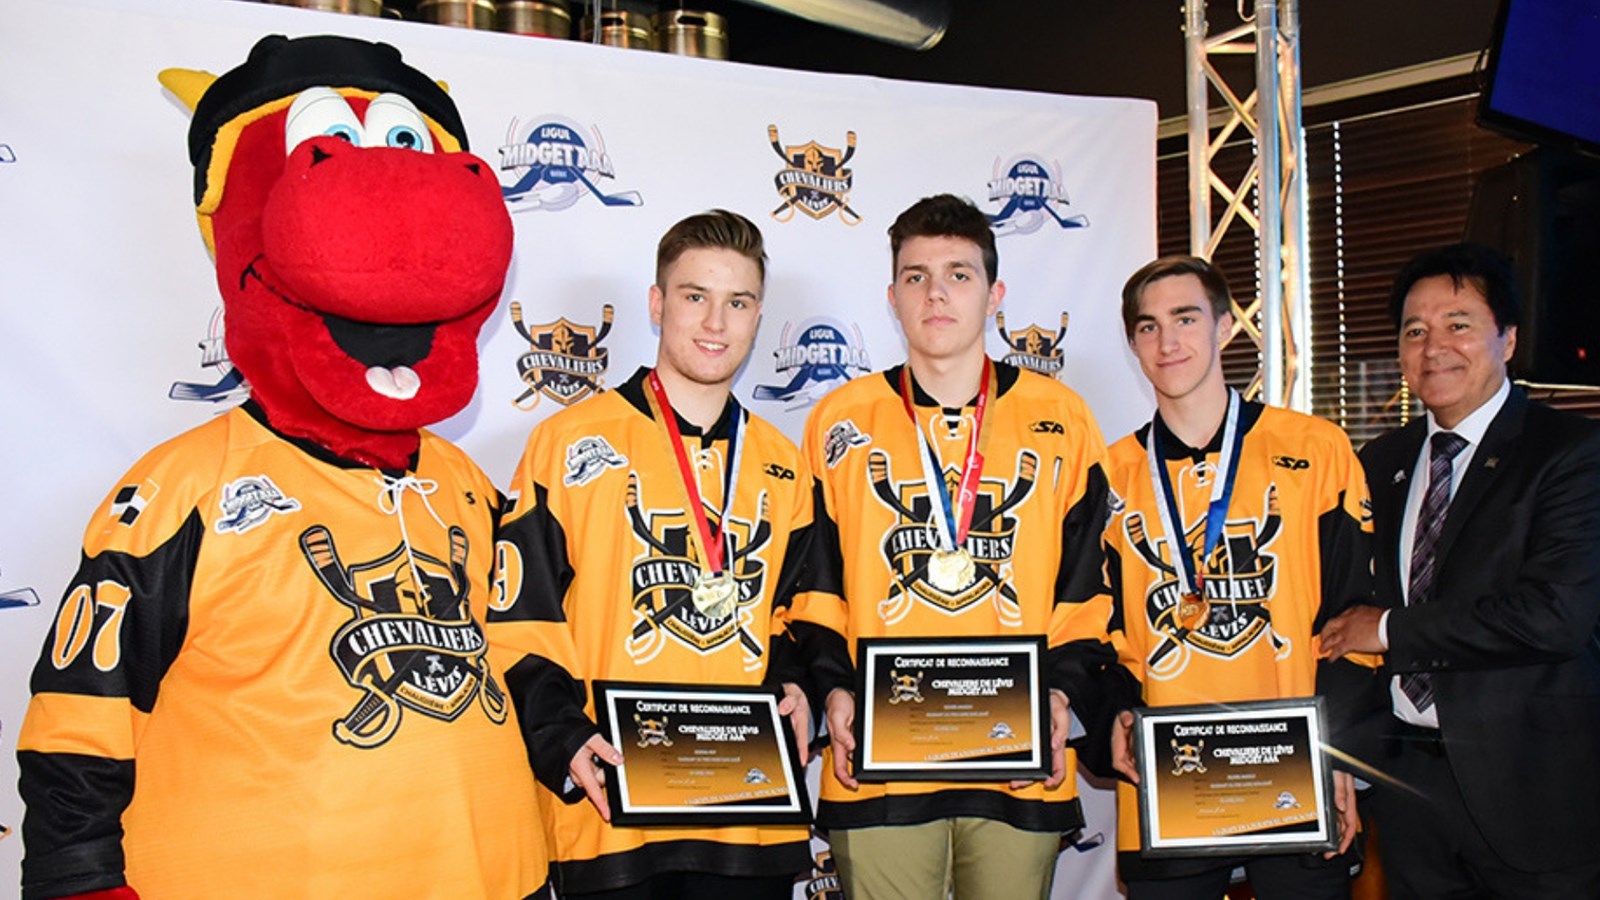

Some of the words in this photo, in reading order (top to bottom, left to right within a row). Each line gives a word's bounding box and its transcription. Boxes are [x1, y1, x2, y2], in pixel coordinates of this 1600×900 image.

[541, 127, 571, 140] LIGUE
[501, 142, 574, 169] MIDGET
[577, 146, 615, 177] AAA
[780, 171, 849, 192] CHEVALIERS
[522, 353, 604, 374] CHEVALIERS
[776, 342, 837, 369] MIDGET
[892, 527, 1013, 558] CHEVIERS
[52, 580, 132, 672] 07
[348, 620, 483, 656] CHEVALIERS
